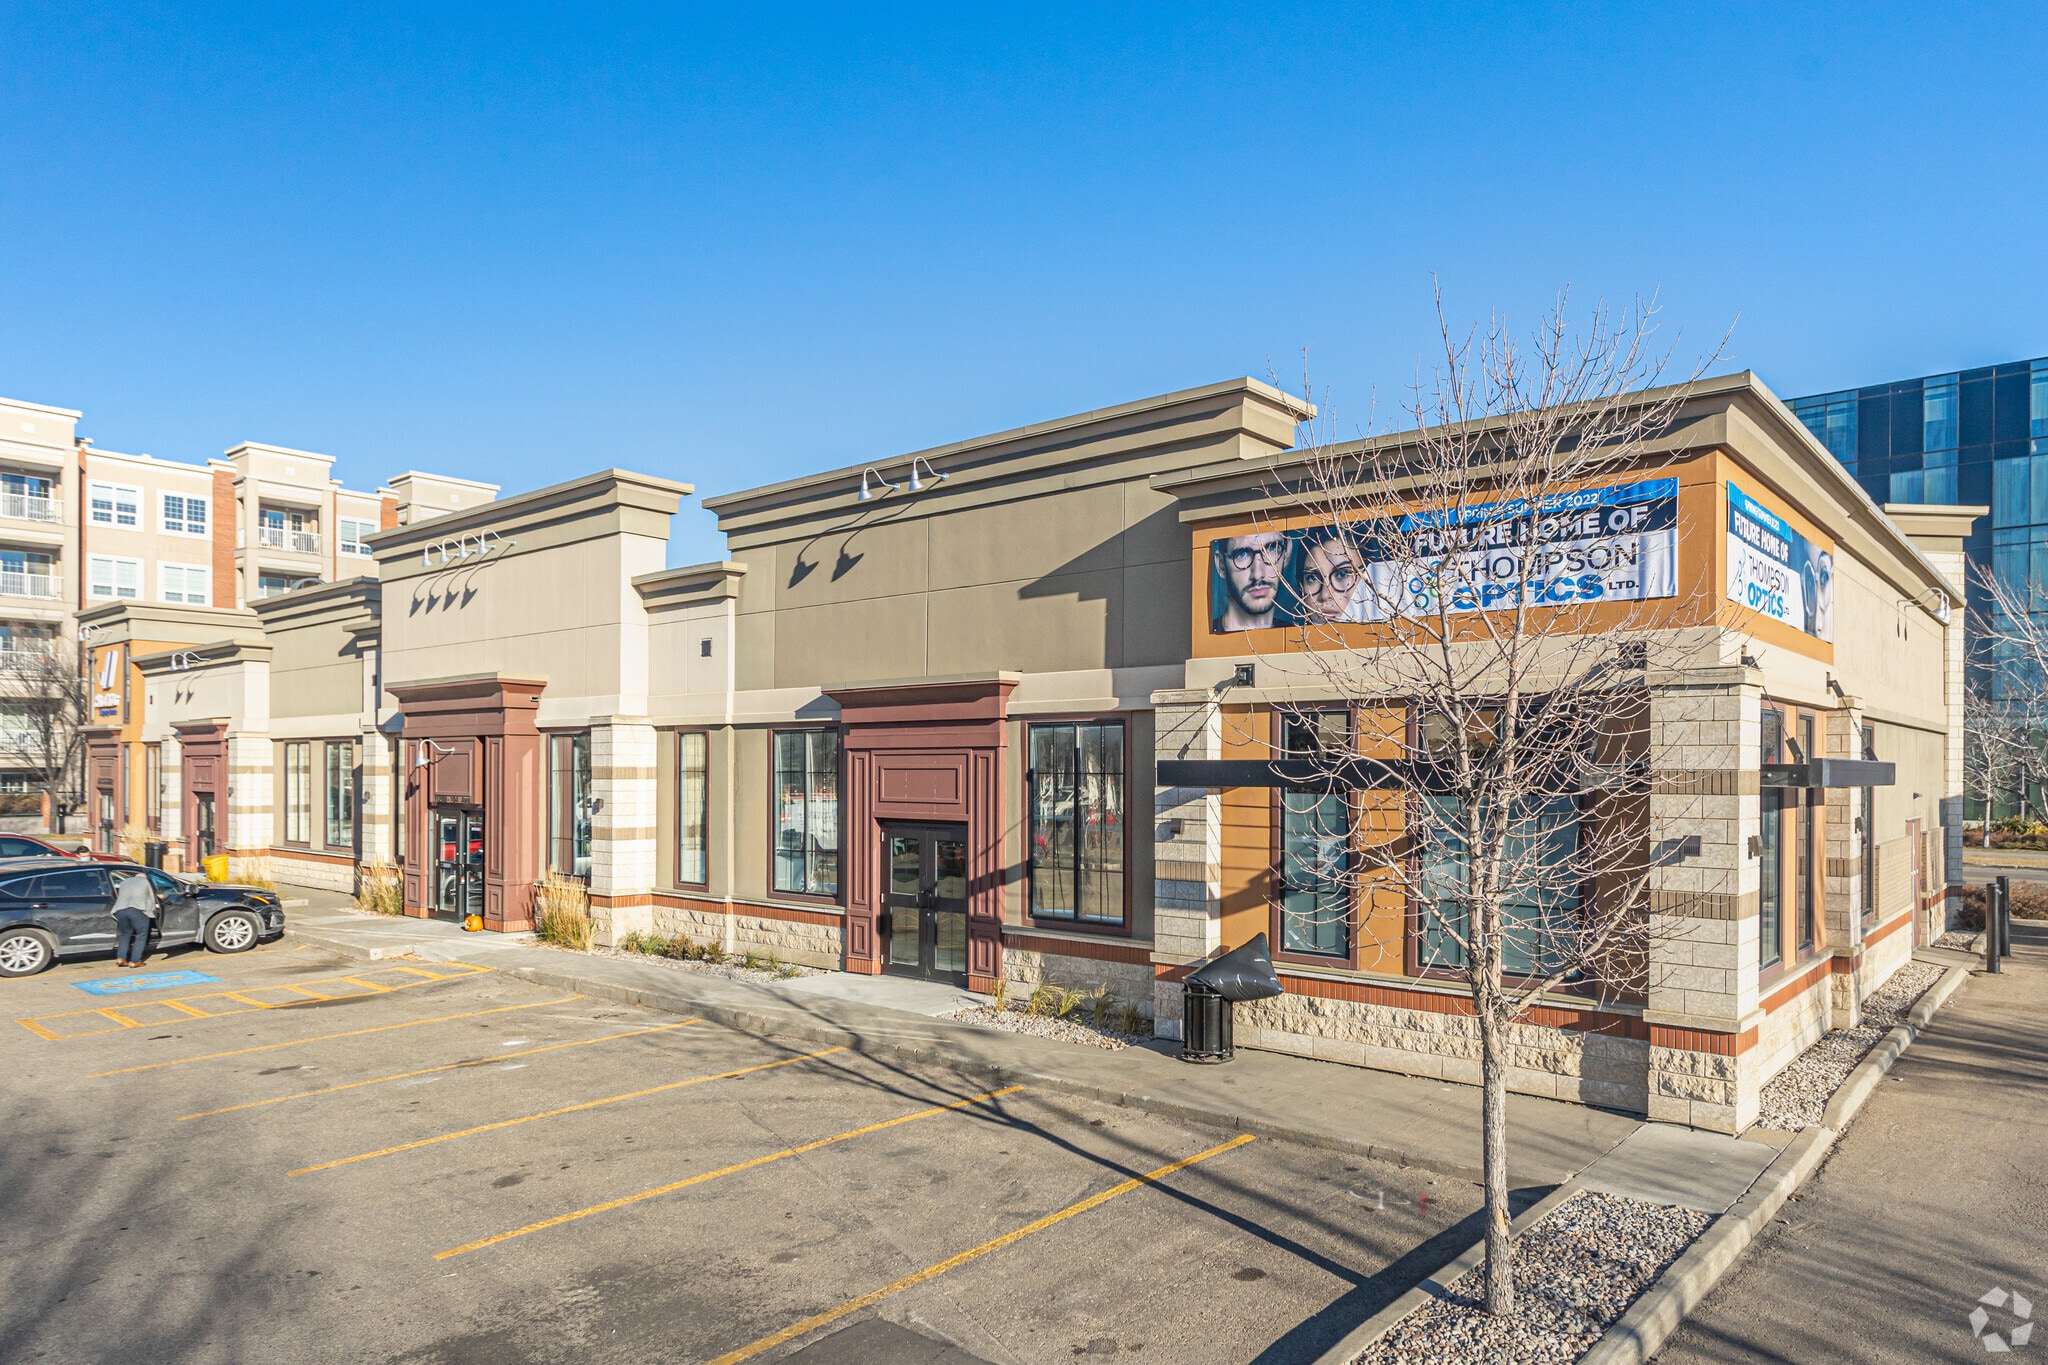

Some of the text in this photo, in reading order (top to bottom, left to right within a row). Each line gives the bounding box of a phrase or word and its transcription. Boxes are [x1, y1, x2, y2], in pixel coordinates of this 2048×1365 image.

[1457, 492, 1598, 521] PRIN SUER 2022
[1414, 521, 1512, 553] FUTURE
[1608, 505, 1648, 531] OF
[1734, 510, 1760, 547] FUTURE
[1761, 529, 1780, 558] HOME
[1780, 541, 1788, 562] OF
[1452, 543, 1637, 582] THOMPSON
[1749, 555, 1790, 594] THOMPSON
[1452, 574, 1639, 609] OPTICS LTD.
[1748, 582, 1783, 618] OPTICS
